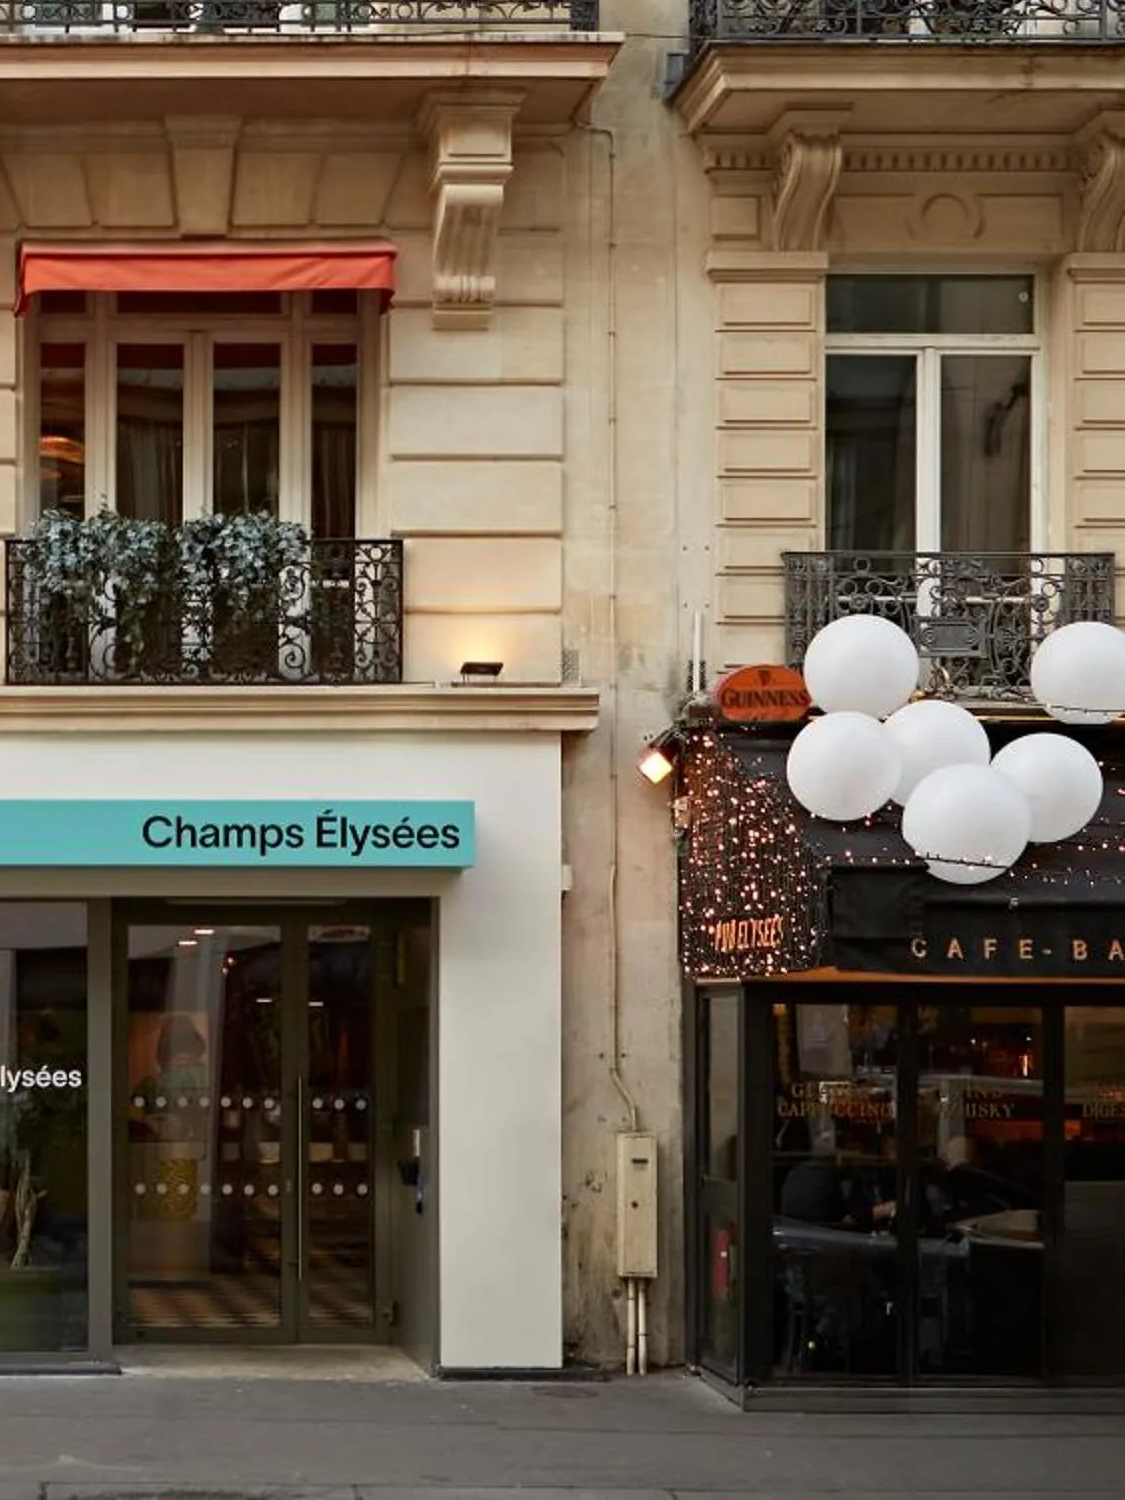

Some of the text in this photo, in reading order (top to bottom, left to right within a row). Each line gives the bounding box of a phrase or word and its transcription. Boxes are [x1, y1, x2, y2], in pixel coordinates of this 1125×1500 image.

[721, 688, 812, 709] GUINNESS
[142, 809, 460, 857] Champs Élysées
